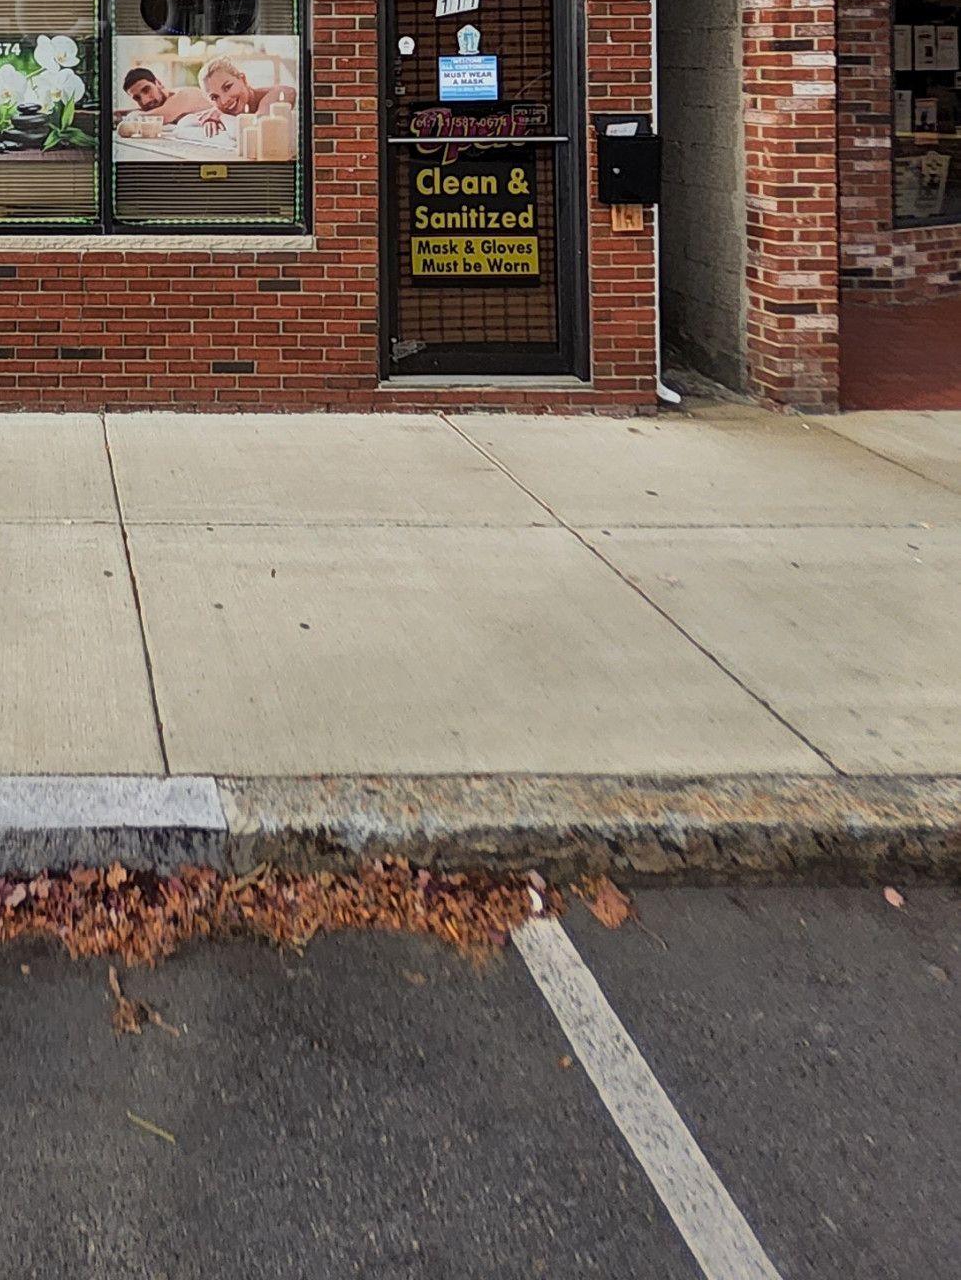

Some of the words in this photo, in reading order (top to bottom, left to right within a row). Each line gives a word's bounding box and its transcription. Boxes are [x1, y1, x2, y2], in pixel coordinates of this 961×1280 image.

[409, 107, 532, 166] Open
[416, 167, 498, 195] Clean
[507, 167, 530, 195] &
[415, 204, 534, 229] Sanitized
[418, 239, 459, 255] Mask
[464, 239, 475, 255] &
[481, 239, 533, 255] Gloves
[421, 257, 459, 273] Must
[463, 257, 482, 273] be
[487, 257, 530, 273] Worn
